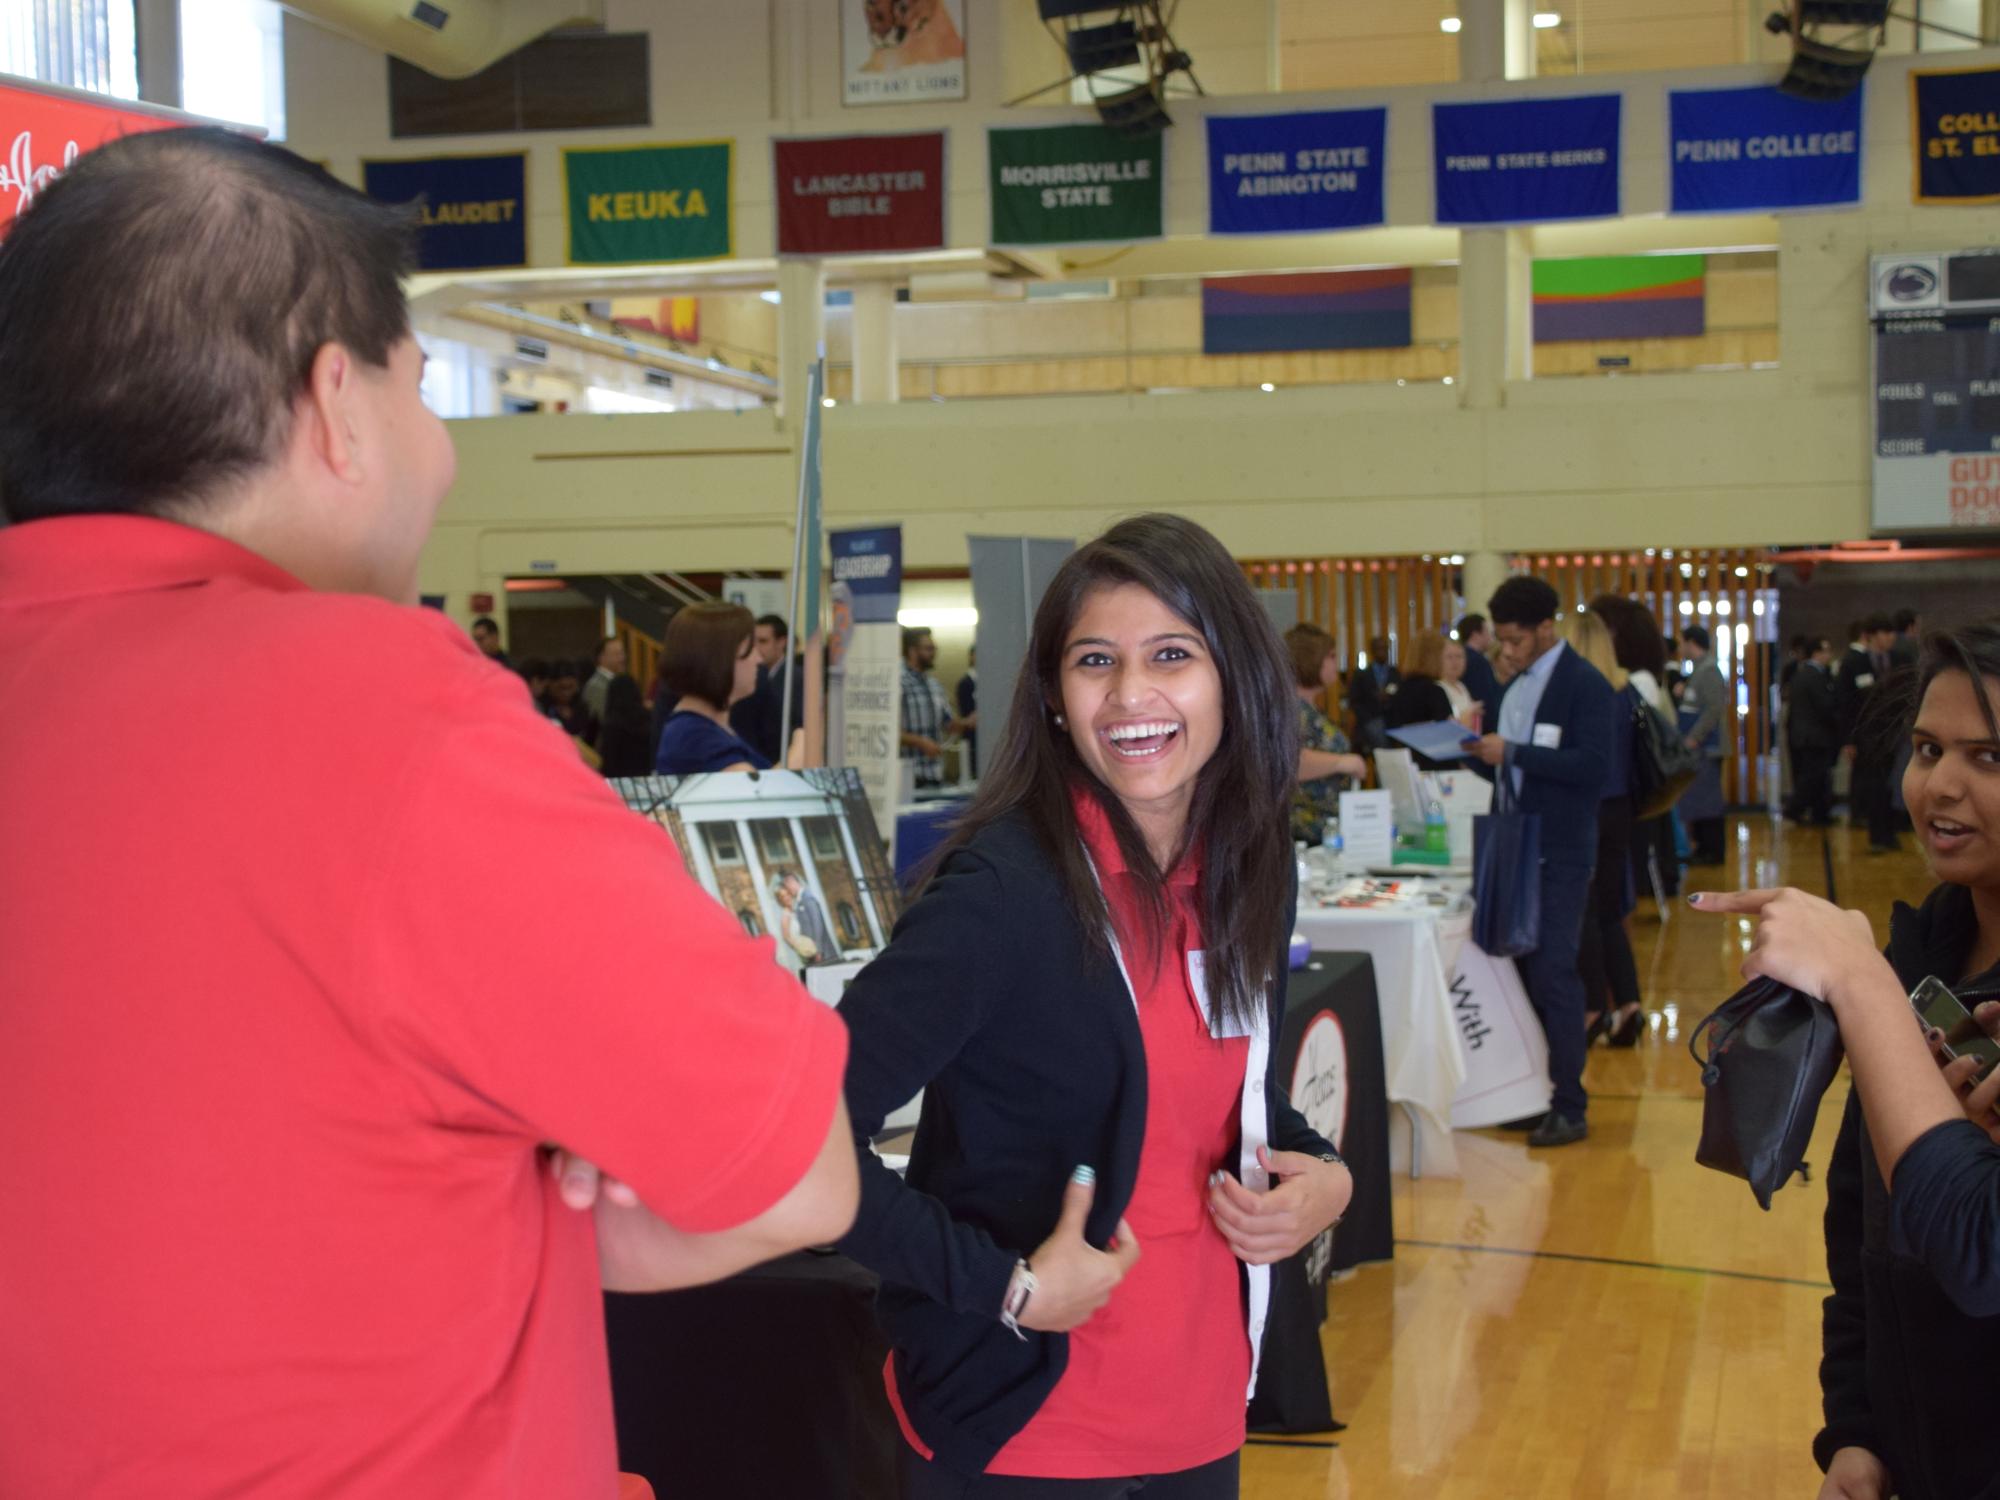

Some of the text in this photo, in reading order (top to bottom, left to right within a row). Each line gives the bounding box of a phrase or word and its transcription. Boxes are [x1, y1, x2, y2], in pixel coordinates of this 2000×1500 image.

[1675, 131, 1856, 163] PENN COLLEGE
[1927, 137, 1963, 159] ST.
[1001, 159, 1150, 186] MORRISVILLE
[1223, 147, 1368, 174] PENN STATE
[1446, 155, 1491, 171] PENN
[793, 171, 925, 196] LANCASTER
[1237, 171, 1357, 197] ABINGTON
[589, 189, 708, 221] KEUKA
[827, 196, 891, 217] BIBLE
[1041, 187, 1111, 209] STATE
[418, 199, 516, 225] LAUDET
[1880, 438, 1926, 456] SCORE
[834, 553, 892, 579] LEADERSHIP
[1449, 974, 1492, 1051] With
